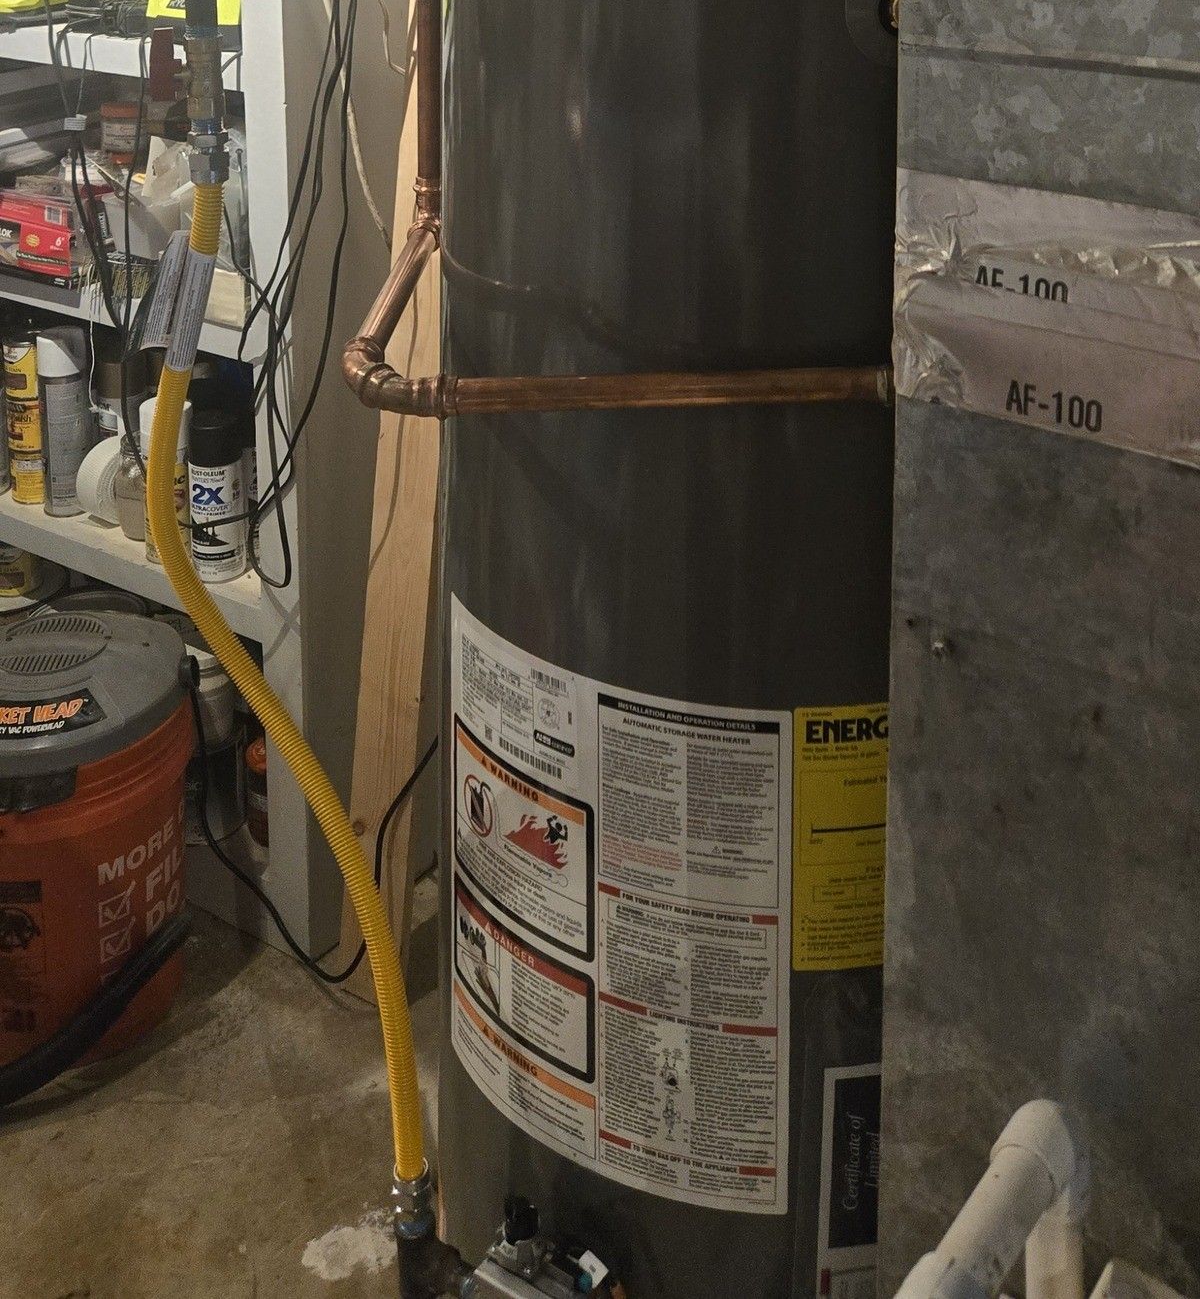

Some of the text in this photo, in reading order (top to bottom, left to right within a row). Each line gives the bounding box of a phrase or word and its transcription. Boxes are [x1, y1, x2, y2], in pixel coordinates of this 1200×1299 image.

[1004, 379, 1103, 433] AF-100
[192, 483, 225, 505] 2X
[33, 698, 84, 723] HEAD
[617, 701, 666, 719] INSTALLATION
[683, 716, 725, 729] OPERATION
[725, 721, 756, 731] DETAILS
[806, 714, 889, 744] ENERG
[622, 717, 752, 746] AUTOMATIC STORAGE WATER HEATER
[488, 760, 539, 802] WARNING
[98, 814, 175, 886] MORE
[146, 879, 181, 938] DO
[651, 899, 673, 912] SAFETY
[691, 908, 715, 920] BEFORE
[715, 912, 751, 923] OPERATING
[492, 928, 536, 968] DANGER
[493, 1036, 539, 1078] WARNING
[841, 1111, 866, 1211] Certificate of
